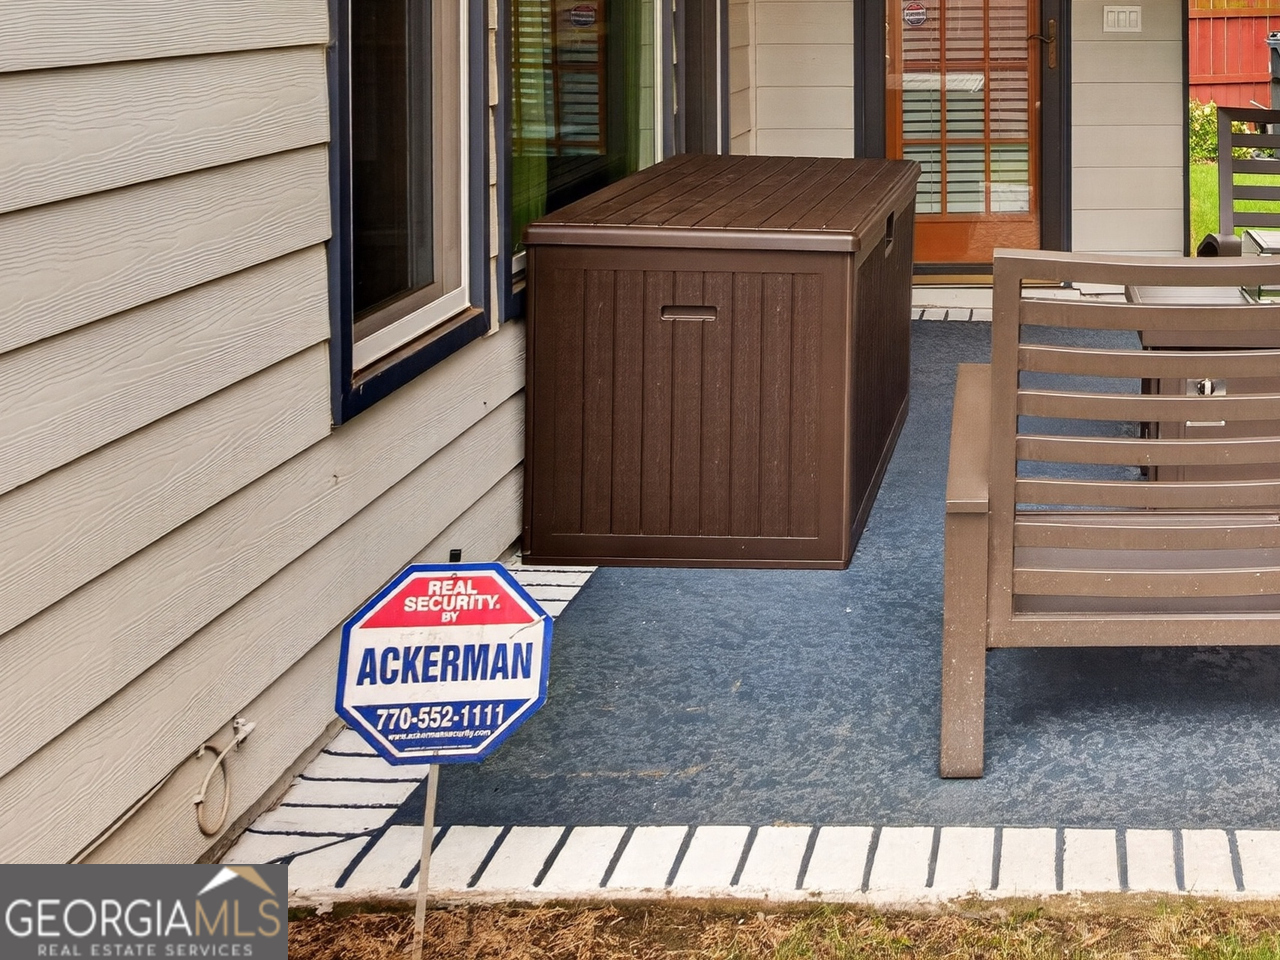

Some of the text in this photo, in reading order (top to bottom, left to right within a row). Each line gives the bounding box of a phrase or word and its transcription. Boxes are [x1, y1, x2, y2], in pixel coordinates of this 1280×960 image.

[428, 579, 478, 596] REAL
[441, 611, 460, 623] BY
[356, 642, 533, 686] ACKERMAN
[376, 703, 505, 731] 770-552-1111
